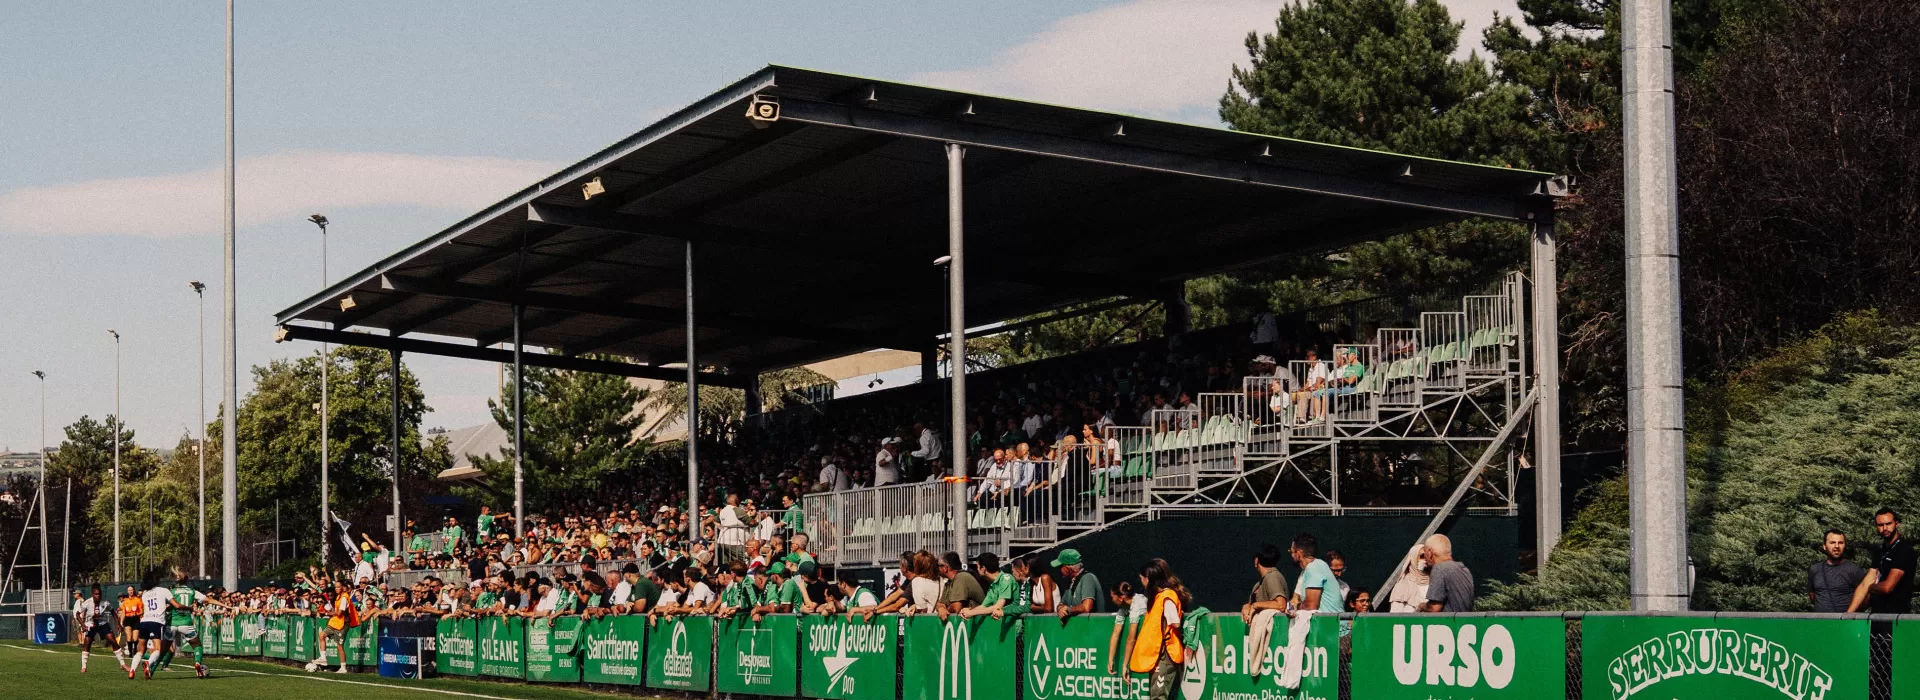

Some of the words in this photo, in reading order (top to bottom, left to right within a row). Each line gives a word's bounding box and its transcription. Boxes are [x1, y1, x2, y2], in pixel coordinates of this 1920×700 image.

[147, 598, 157, 611] 15
[809, 624, 838, 656] sport
[847, 624, 886, 653] avenue
[1056, 647, 1097, 669] LOIRE
[1211, 634, 1237, 674] La
[1393, 624, 1516, 689] URSO
[1608, 628, 1833, 700] SERRURERIE
[624, 664, 638, 679] design
[843, 675, 855, 695] pro
[1054, 675, 1151, 700] ASCENSEURS
